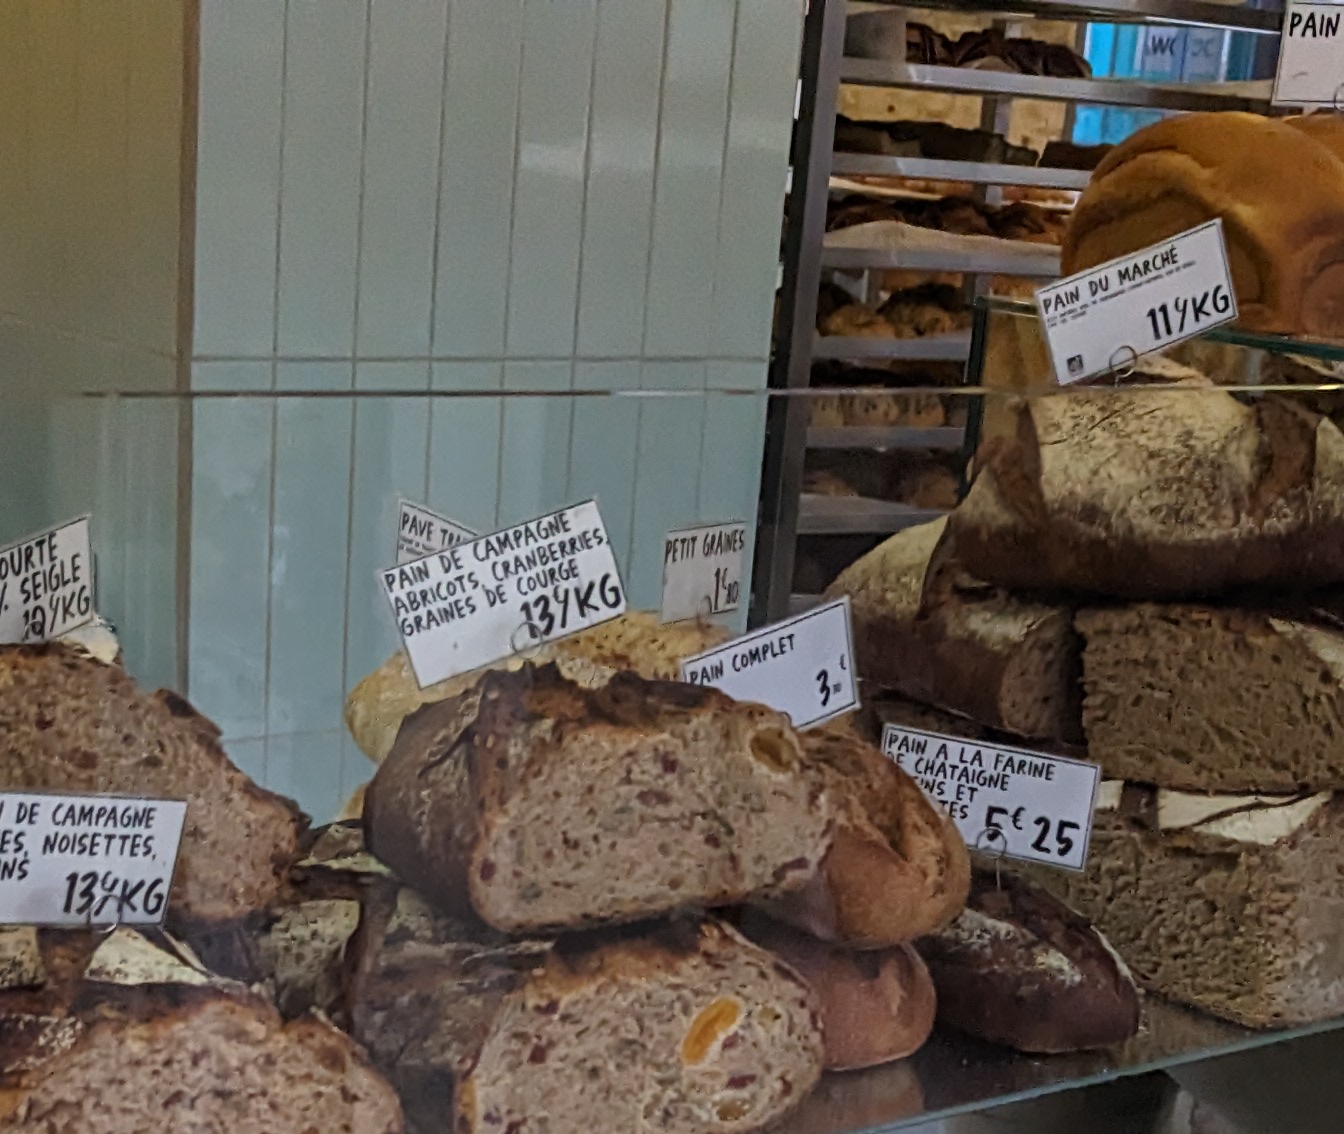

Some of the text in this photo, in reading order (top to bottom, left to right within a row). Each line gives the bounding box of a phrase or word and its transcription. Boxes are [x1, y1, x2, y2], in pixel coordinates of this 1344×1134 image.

[1289, 12, 1341, 38] PAIN
[1043, 285, 1080, 315] PAIN
[1088, 274, 1110, 297] DU
[1117, 244, 1180, 286] MARCHÉ
[384, 562, 430, 593] PAIN
[440, 552, 464, 574] DE
[472, 512, 572, 562] CAMPAGNE
[665, 528, 745, 565] PETIT GRAINES
[20, 553, 81, 604] SEIGLE
[400, 558, 579, 637] GRAINES DE COURGE
[689, 634, 796, 686] PAIN COMPLET
[888, 732, 1057, 781] PAIN A LA FARINE
[915, 757, 1011, 792] CHATAIGNE
[956, 784, 978, 803] ET
[16, 802, 40, 825] DE
[52, 803, 157, 829] CAMPAGNE
[42, 833, 157, 861] NOISETTES,
